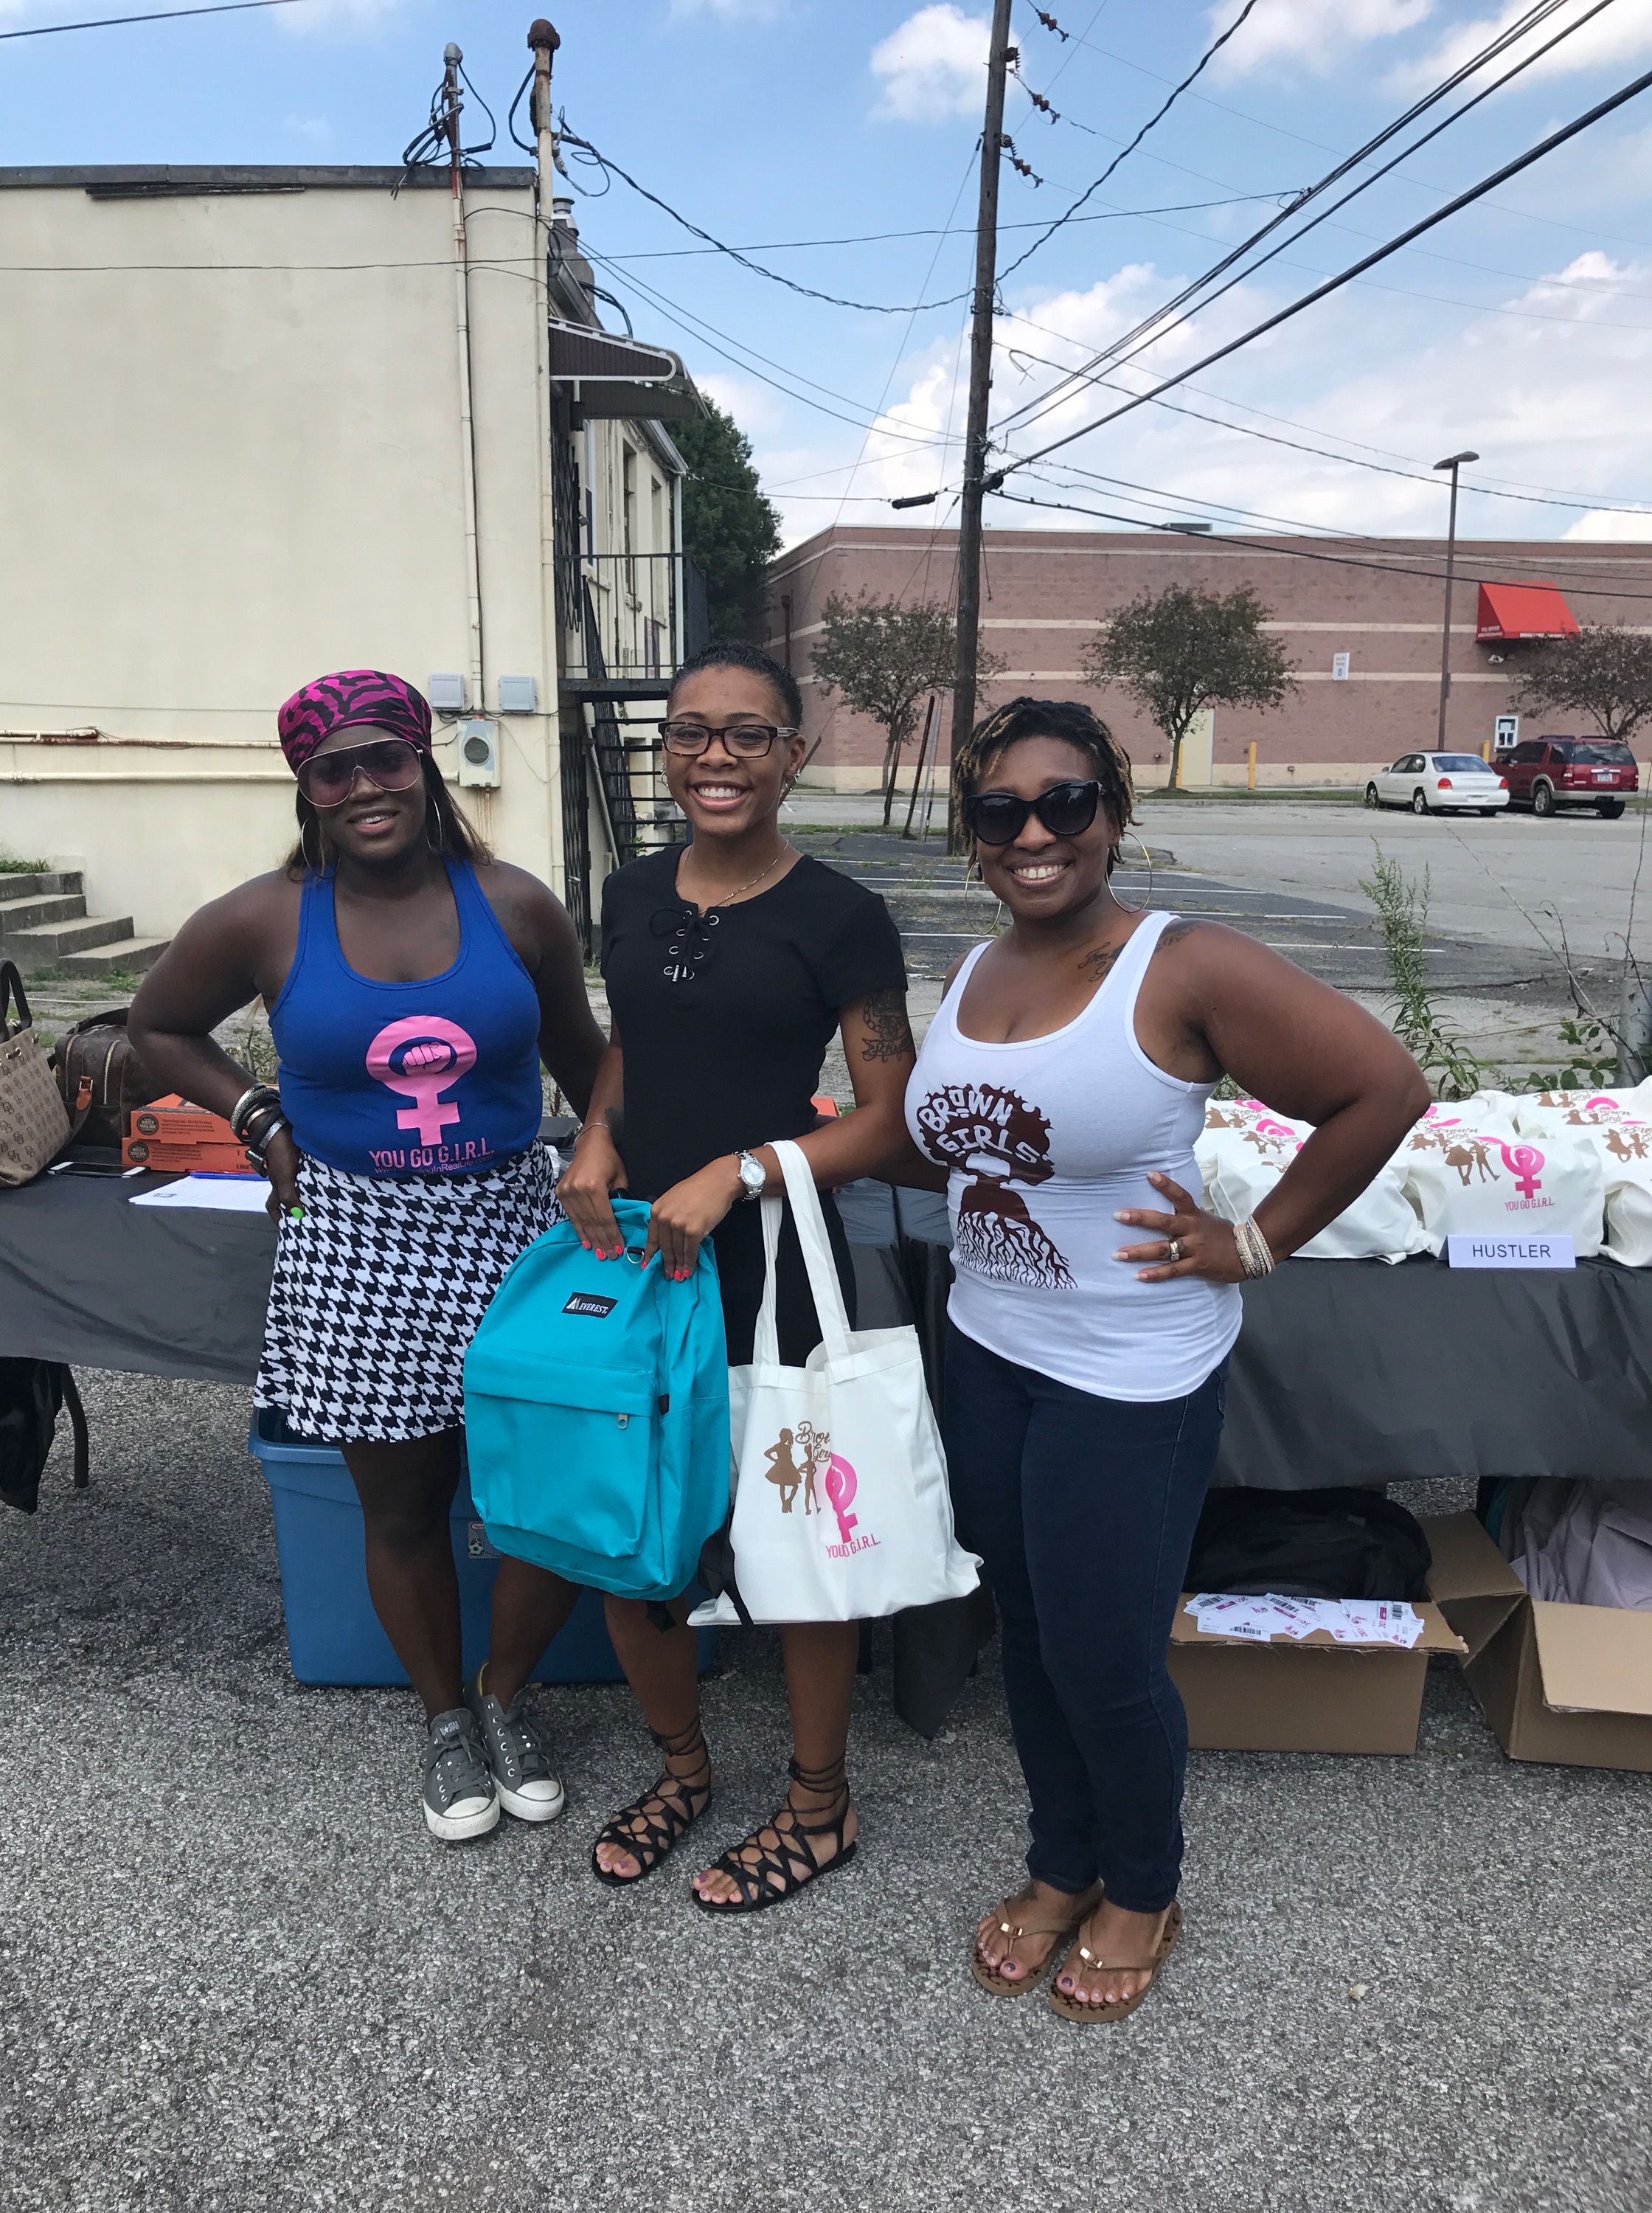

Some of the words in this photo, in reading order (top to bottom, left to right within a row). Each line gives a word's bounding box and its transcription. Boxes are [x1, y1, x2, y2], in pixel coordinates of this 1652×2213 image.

[918, 1089, 1013, 1132] BROWN
[369, 1150, 406, 1168] YOU
[409, 1148, 434, 1168] GO
[437, 1137, 495, 1163] G.I.R.L.
[936, 1124, 1041, 1164] GIRLS
[1504, 1200, 1519, 1211] YOU
[1520, 1199, 1530, 1210] GO
[1472, 1244, 1551, 1258] HUSTLER
[578, 1302, 609, 1314] EVEREST
[850, 1534, 881, 1554] G.I.R.L.
